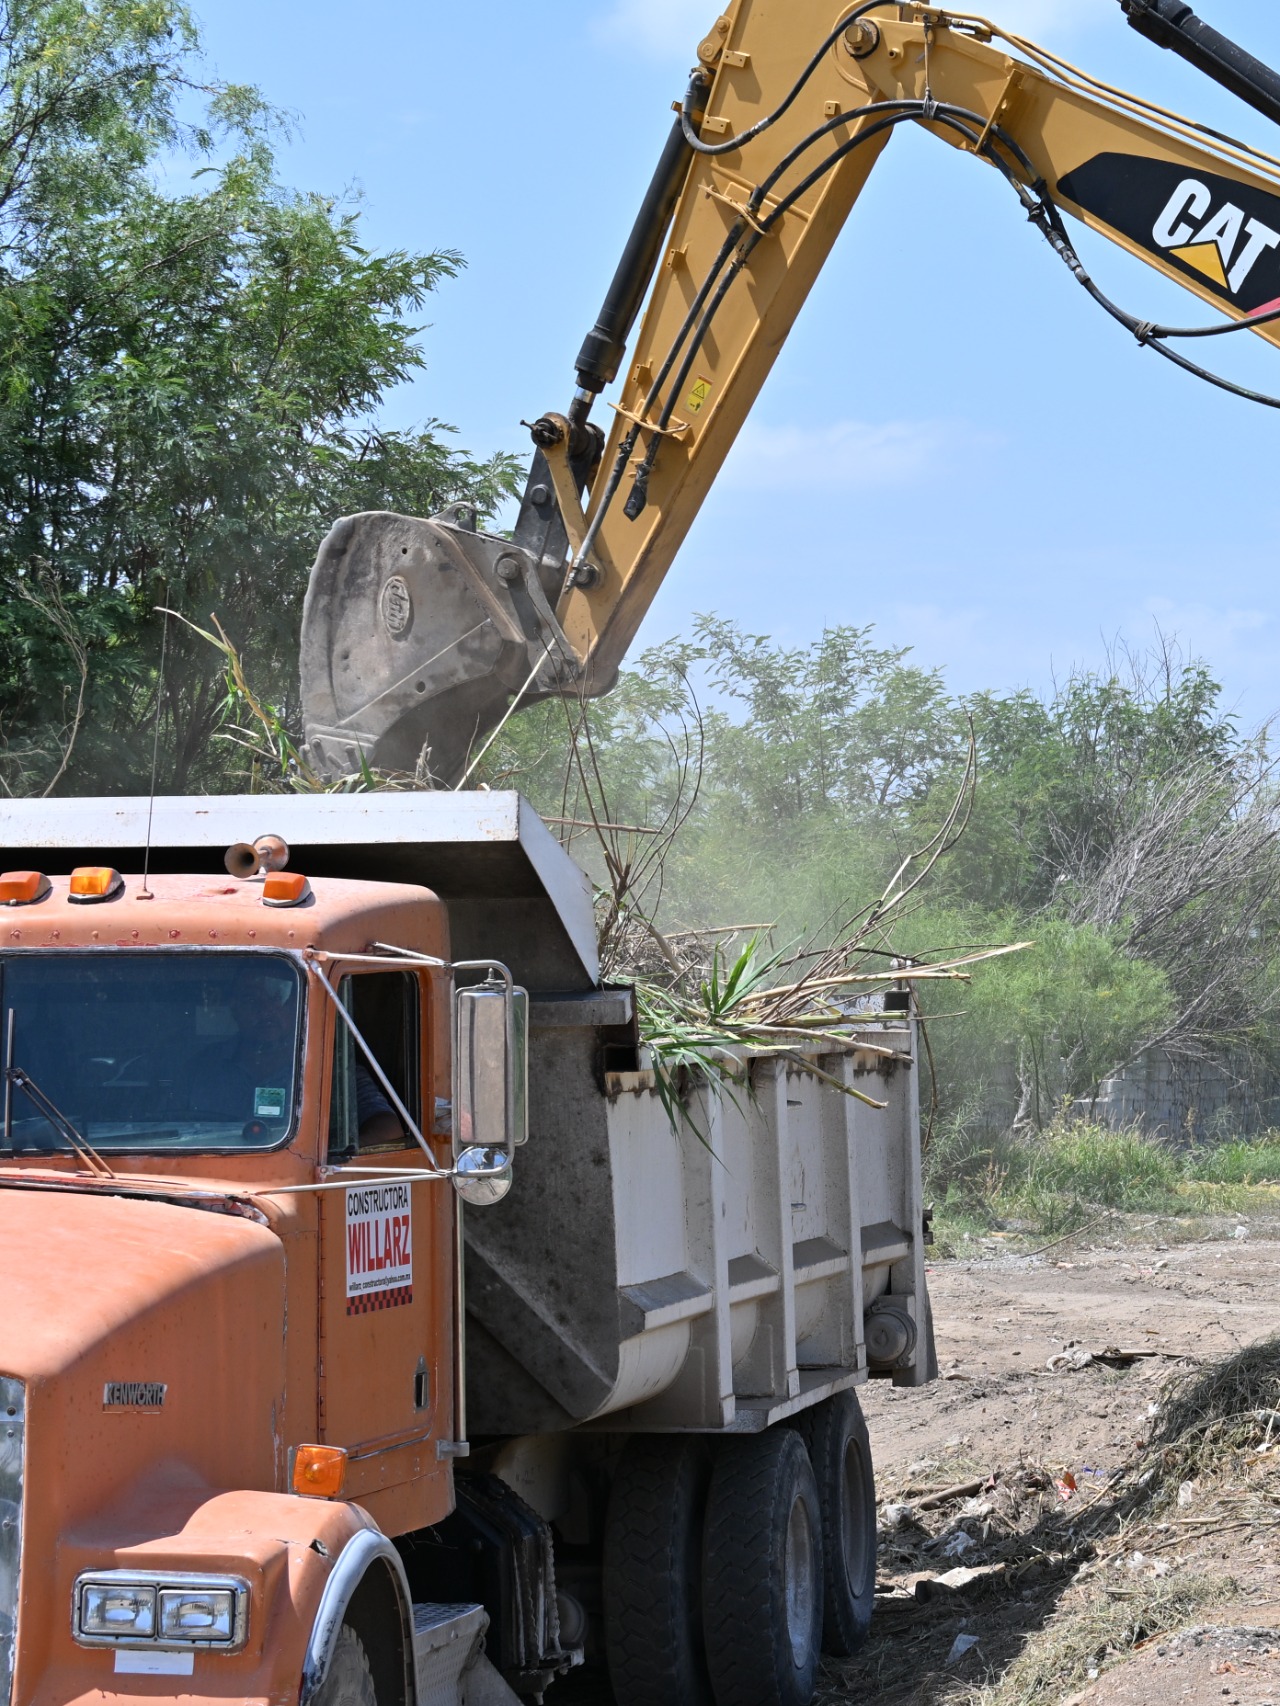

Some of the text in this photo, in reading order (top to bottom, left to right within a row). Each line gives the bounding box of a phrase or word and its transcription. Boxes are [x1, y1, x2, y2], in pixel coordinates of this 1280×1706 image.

[347, 1185, 408, 1216] CONSTRUCTORA
[348, 1214, 410, 1275] WILLARZ
[105, 1382, 165, 1406] KENWORTH
